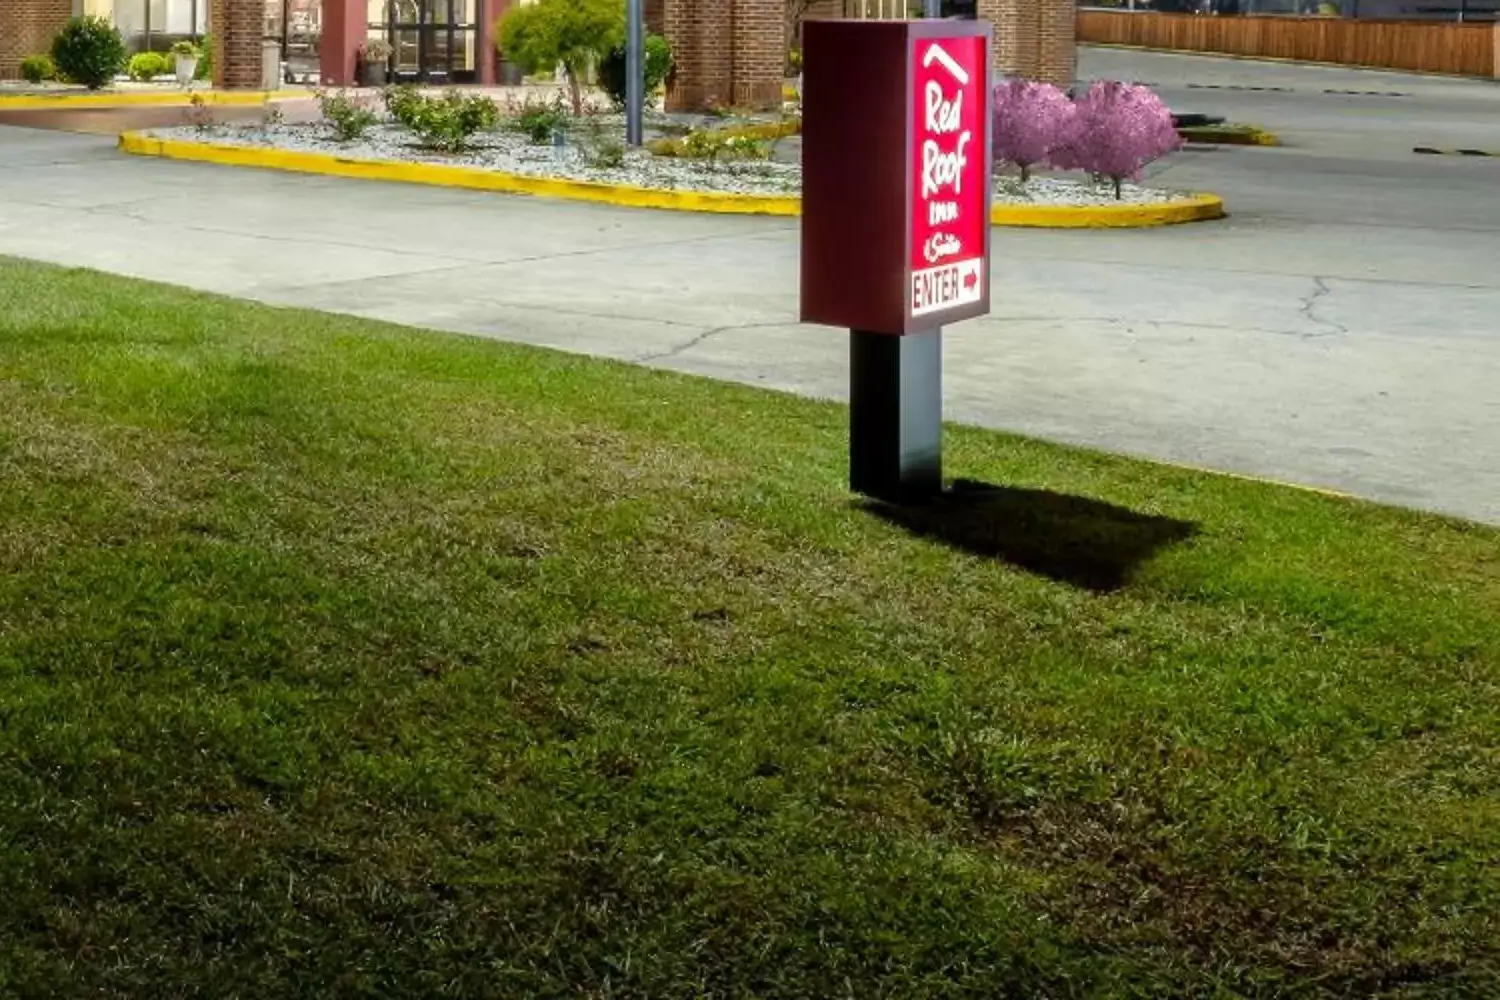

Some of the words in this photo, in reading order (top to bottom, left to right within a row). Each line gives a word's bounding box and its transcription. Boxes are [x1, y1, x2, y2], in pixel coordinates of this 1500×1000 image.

[925, 80, 962, 134] Red
[922, 131, 970, 200] Roof
[913, 268, 959, 309] ENTER
